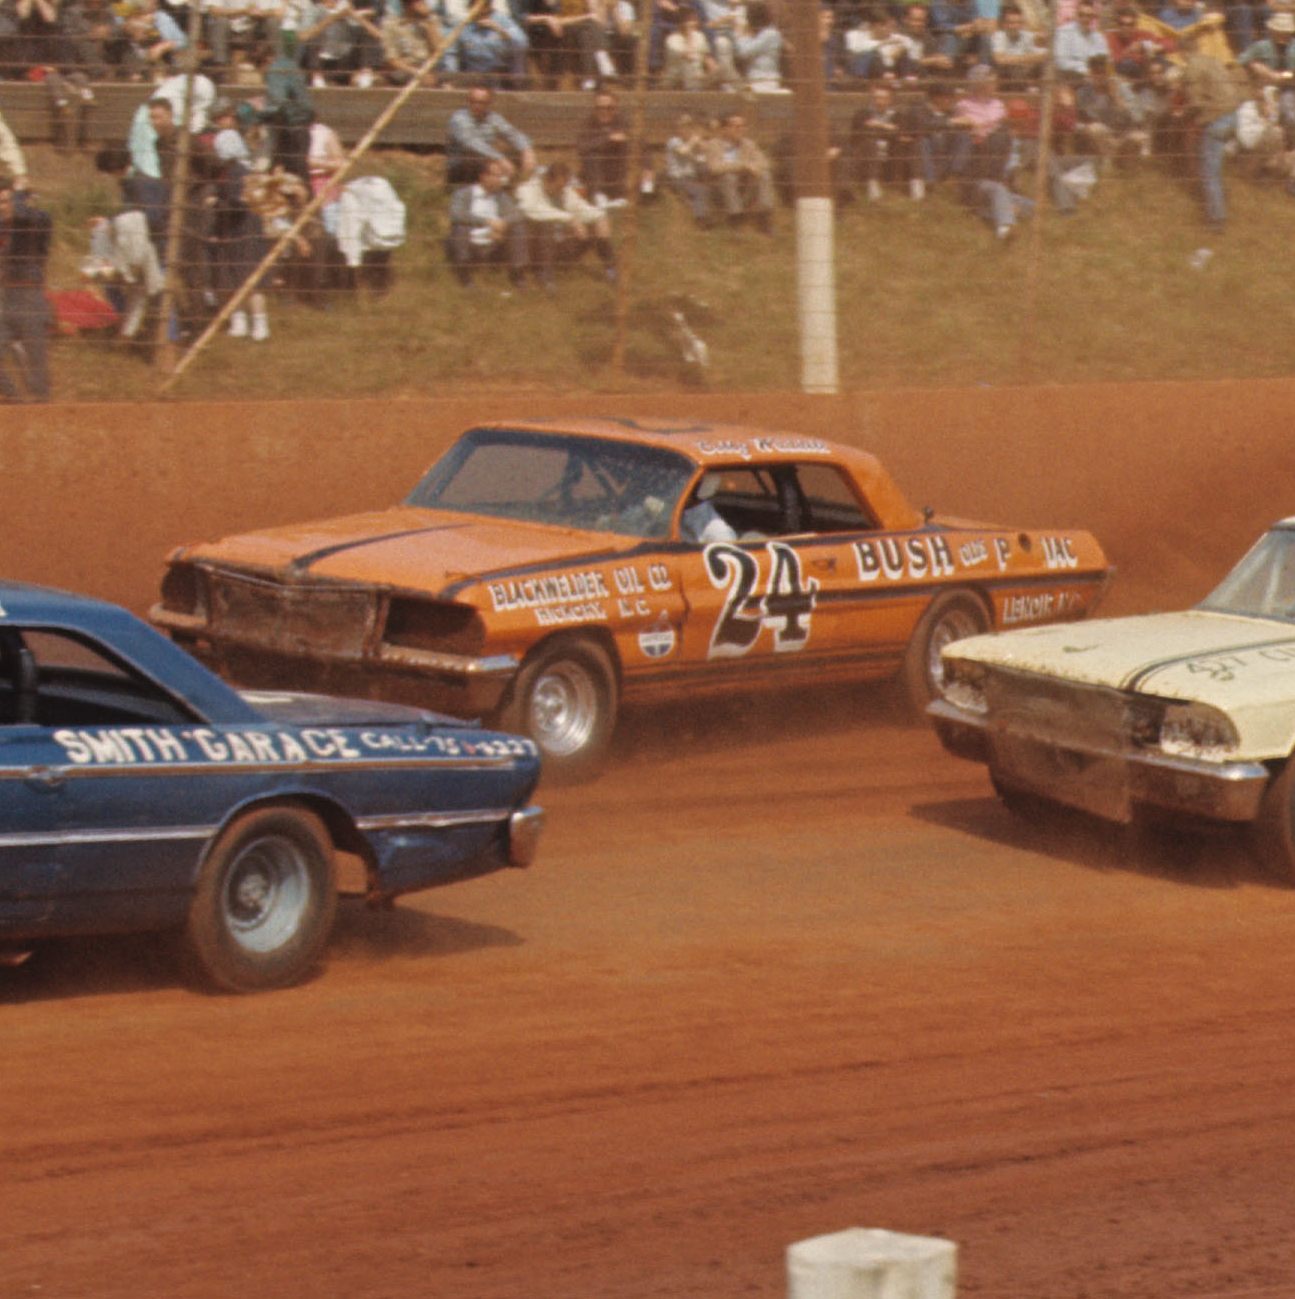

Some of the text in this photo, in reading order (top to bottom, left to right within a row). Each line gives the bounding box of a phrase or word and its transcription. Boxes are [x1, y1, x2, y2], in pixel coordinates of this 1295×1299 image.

[852, 536, 954, 582] BUSH
[614, 566, 644, 595] OIL
[702, 542, 820, 660] 24
[53, 728, 188, 764] SMITH
